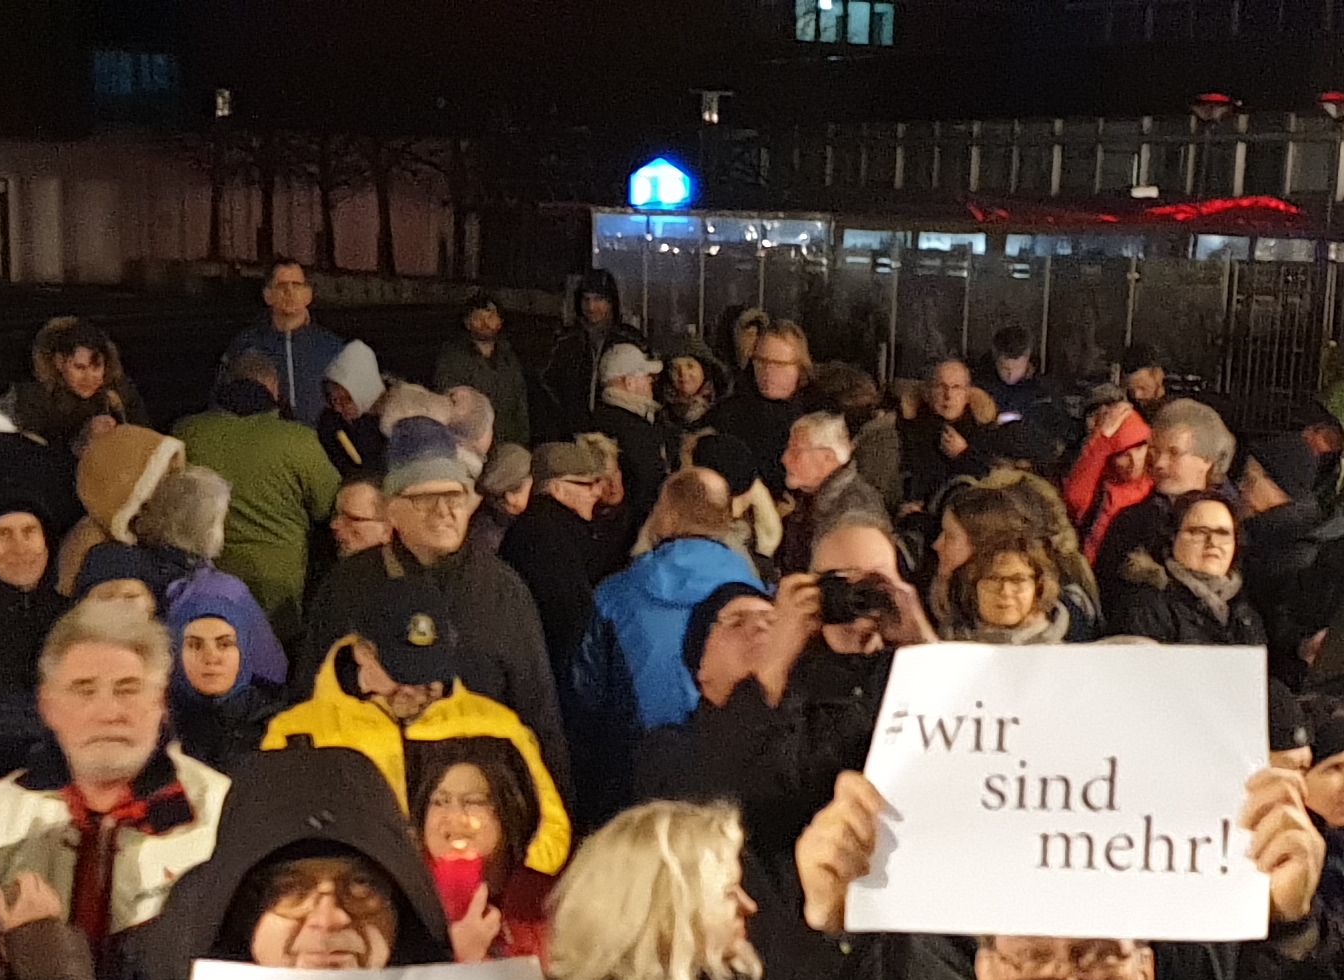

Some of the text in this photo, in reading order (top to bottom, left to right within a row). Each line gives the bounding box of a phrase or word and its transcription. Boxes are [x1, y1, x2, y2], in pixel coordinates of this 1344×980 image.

[885, 701, 1020, 755] #wir
[980, 756, 1119, 813] sind
[1035, 815, 1231, 875] mehr!
